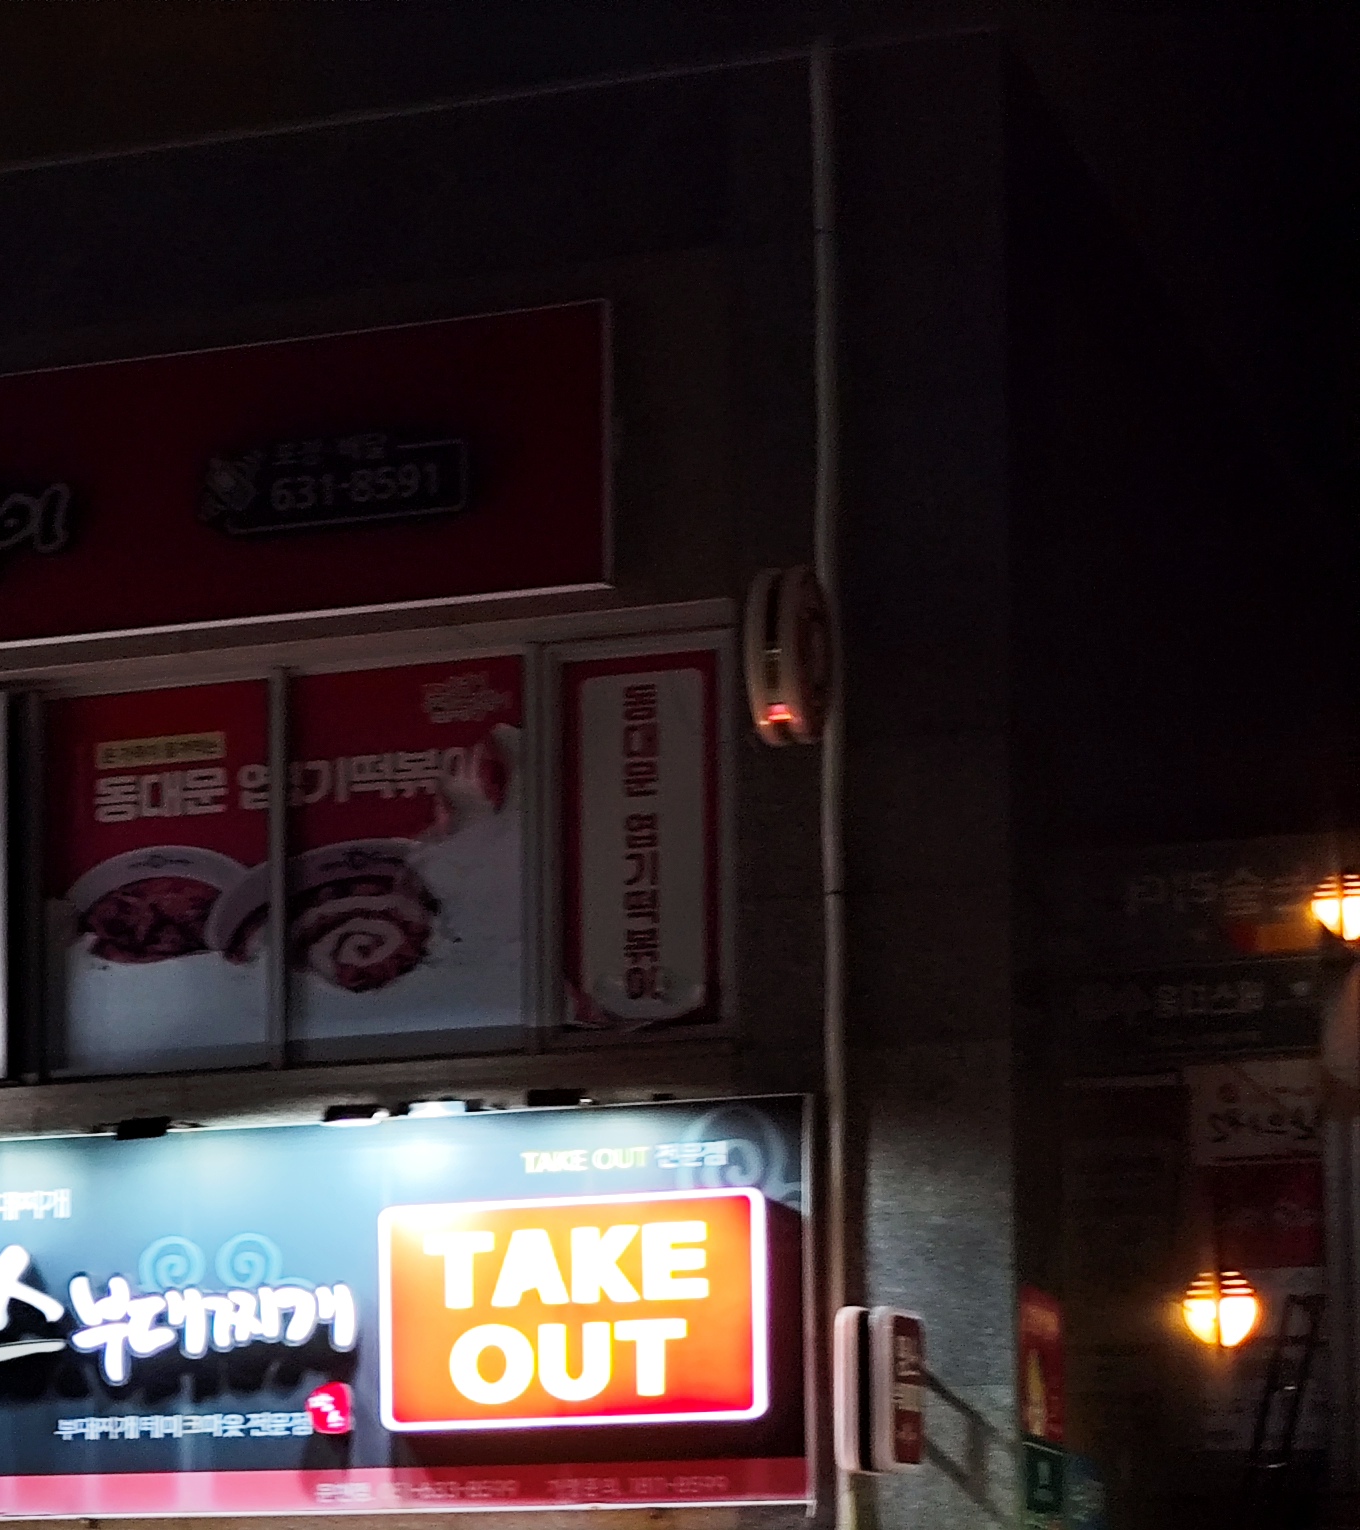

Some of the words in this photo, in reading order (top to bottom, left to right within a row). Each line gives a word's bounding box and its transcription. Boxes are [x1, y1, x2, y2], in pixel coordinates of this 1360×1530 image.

[623, 684, 659, 797] 동대문
[93, 766, 228, 824] 동대문
[520, 1148, 588, 1174] TAKE
[592, 1145, 650, 1171] OUT
[423, 1221, 709, 1309] TAKE
[449, 1318, 688, 1405] OUT
